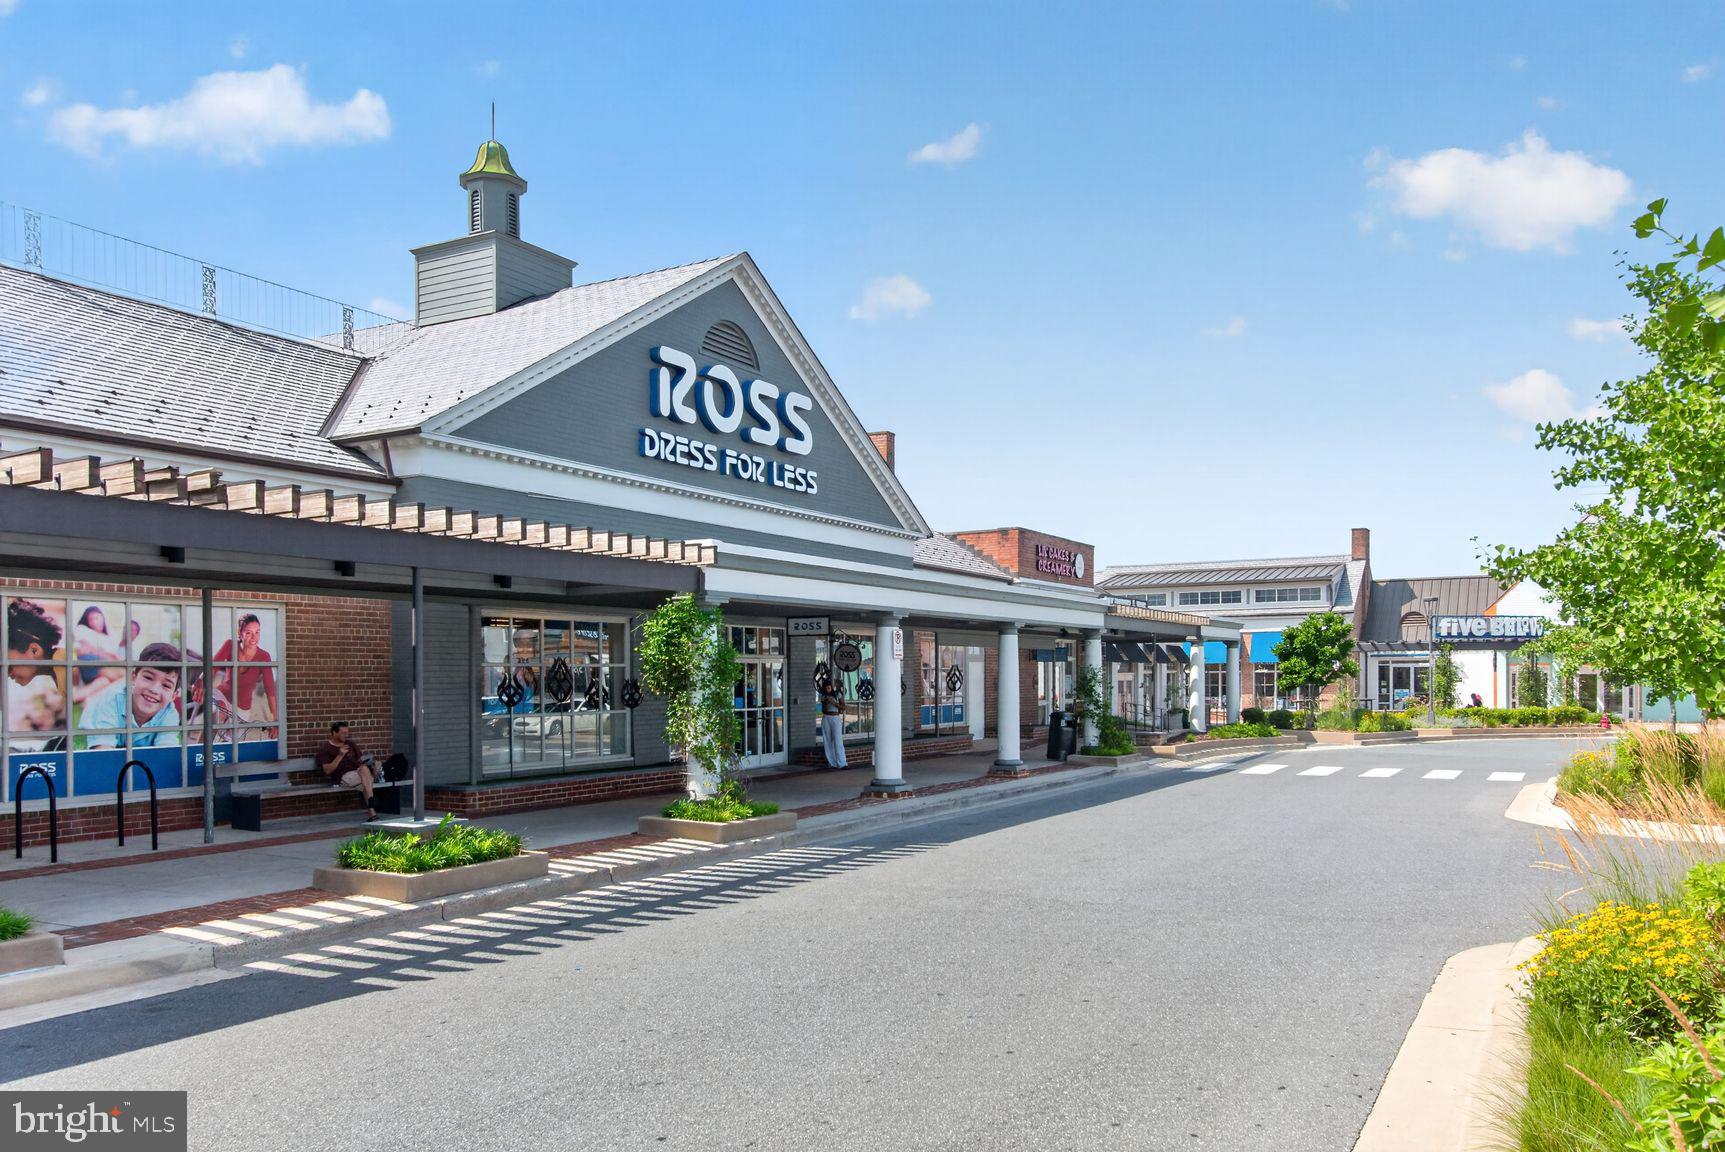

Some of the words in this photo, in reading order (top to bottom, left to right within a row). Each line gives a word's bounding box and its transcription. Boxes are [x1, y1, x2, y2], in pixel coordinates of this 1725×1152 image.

[650, 345, 813, 456] ROSS
[639, 427, 718, 472] DRESS
[720, 448, 766, 483] FOR
[768, 460, 819, 495] LESS
[1038, 559, 1075, 577] CREAMERY
[793, 621, 822, 631] ROSS
[1438, 617, 1487, 637] five
[1490, 616, 1544, 637] BELOW
